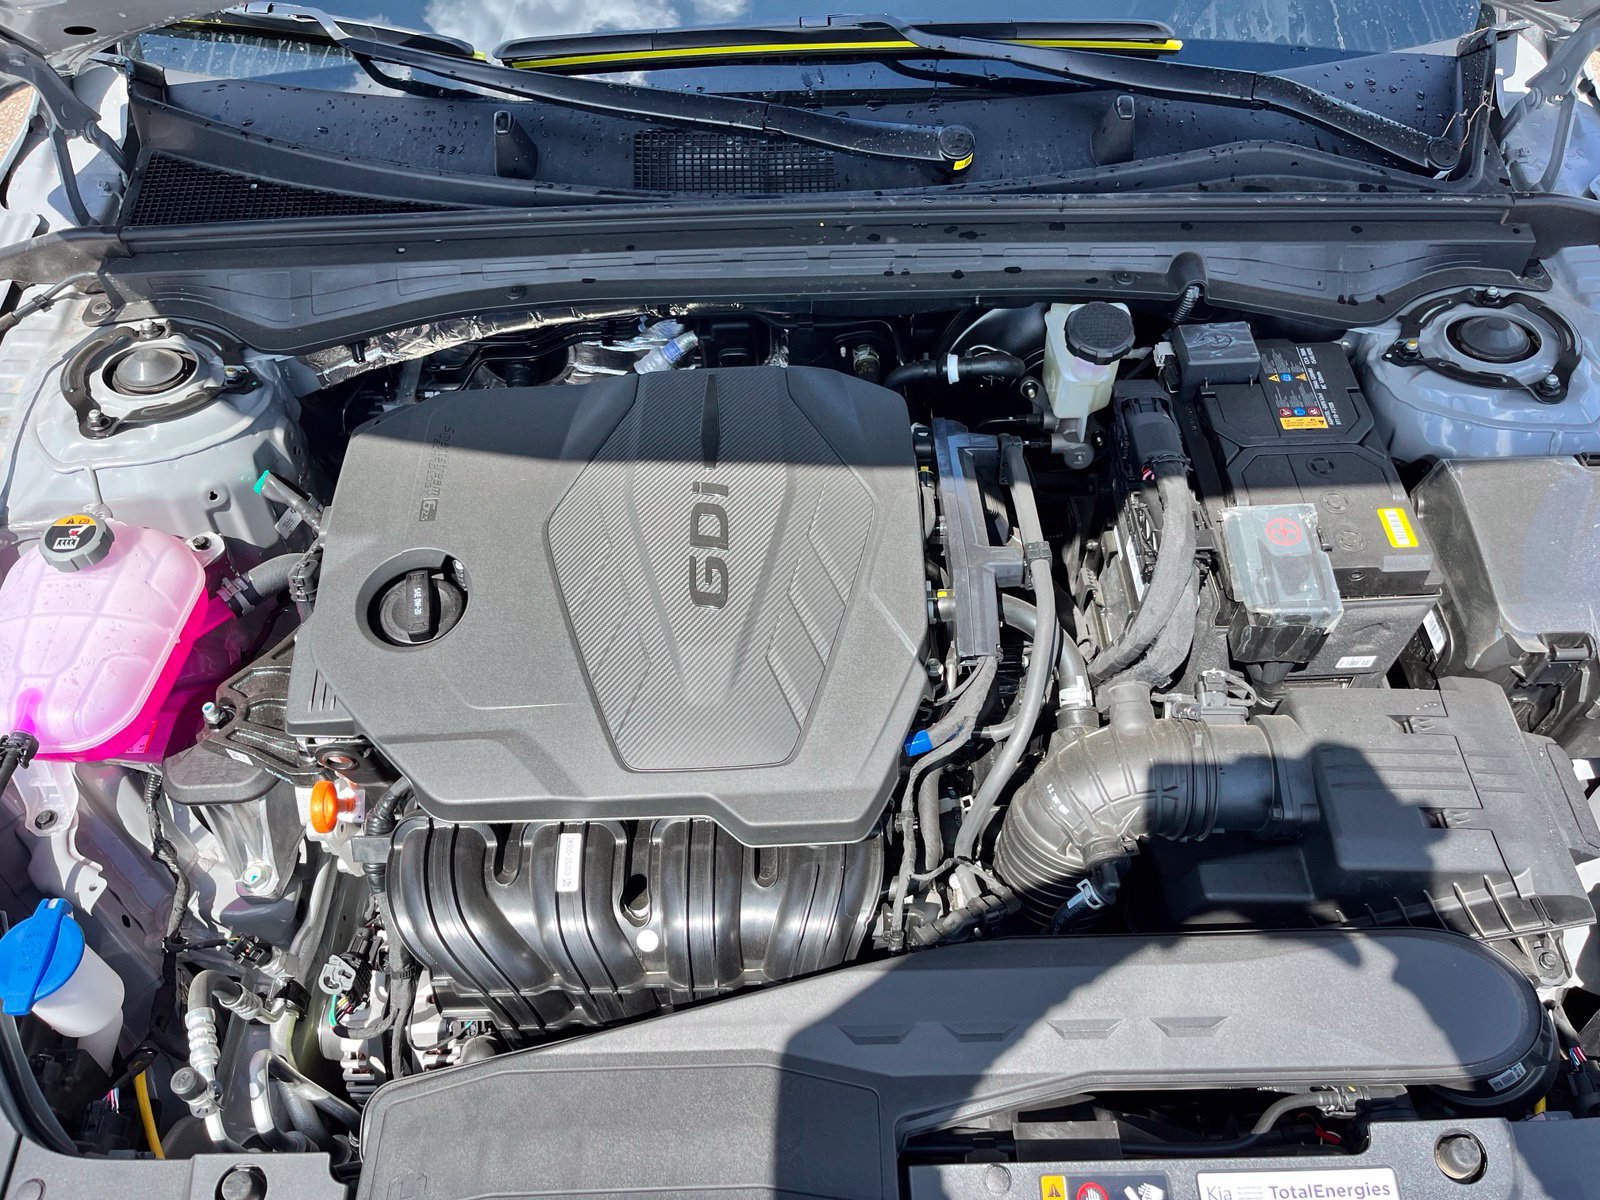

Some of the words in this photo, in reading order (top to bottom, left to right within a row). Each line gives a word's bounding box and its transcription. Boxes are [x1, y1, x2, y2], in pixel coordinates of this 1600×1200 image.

[690, 481, 729, 610] GDi
[413, 587, 422, 598] SAE
[1207, 1186, 1232, 1200] Kia
[1268, 1182, 1391, 1200] TotalEnergies
